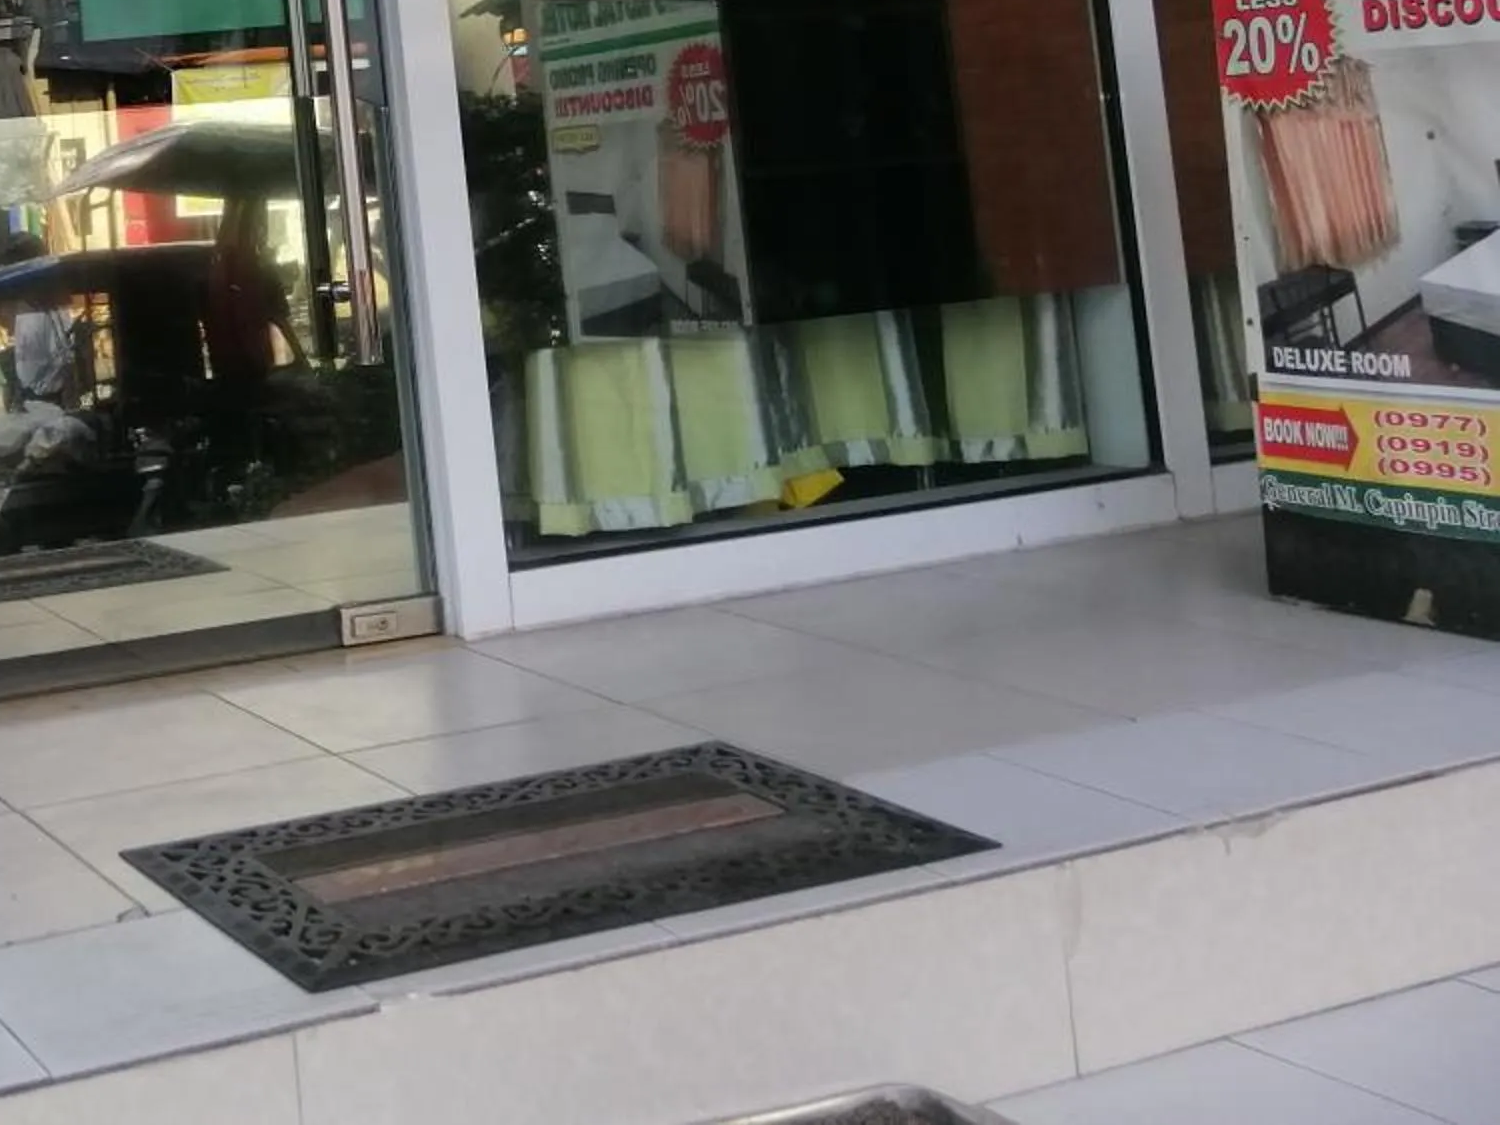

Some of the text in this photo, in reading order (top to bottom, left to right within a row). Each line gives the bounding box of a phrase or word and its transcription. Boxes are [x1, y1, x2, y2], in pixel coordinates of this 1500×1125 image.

[1222, 12, 1320, 76] 20%
[1272, 347, 1412, 378] DELUXE ROOM
[1263, 418, 1304, 444] BOOK
[1374, 410, 1487, 436] (0977)
[1376, 435, 1489, 463] (0919)
[1377, 457, 1492, 487] (0995)
[1262, 475, 1330, 511] General
[1331, 483, 1363, 513] M.
[1364, 488, 1461, 530] Capinpin
